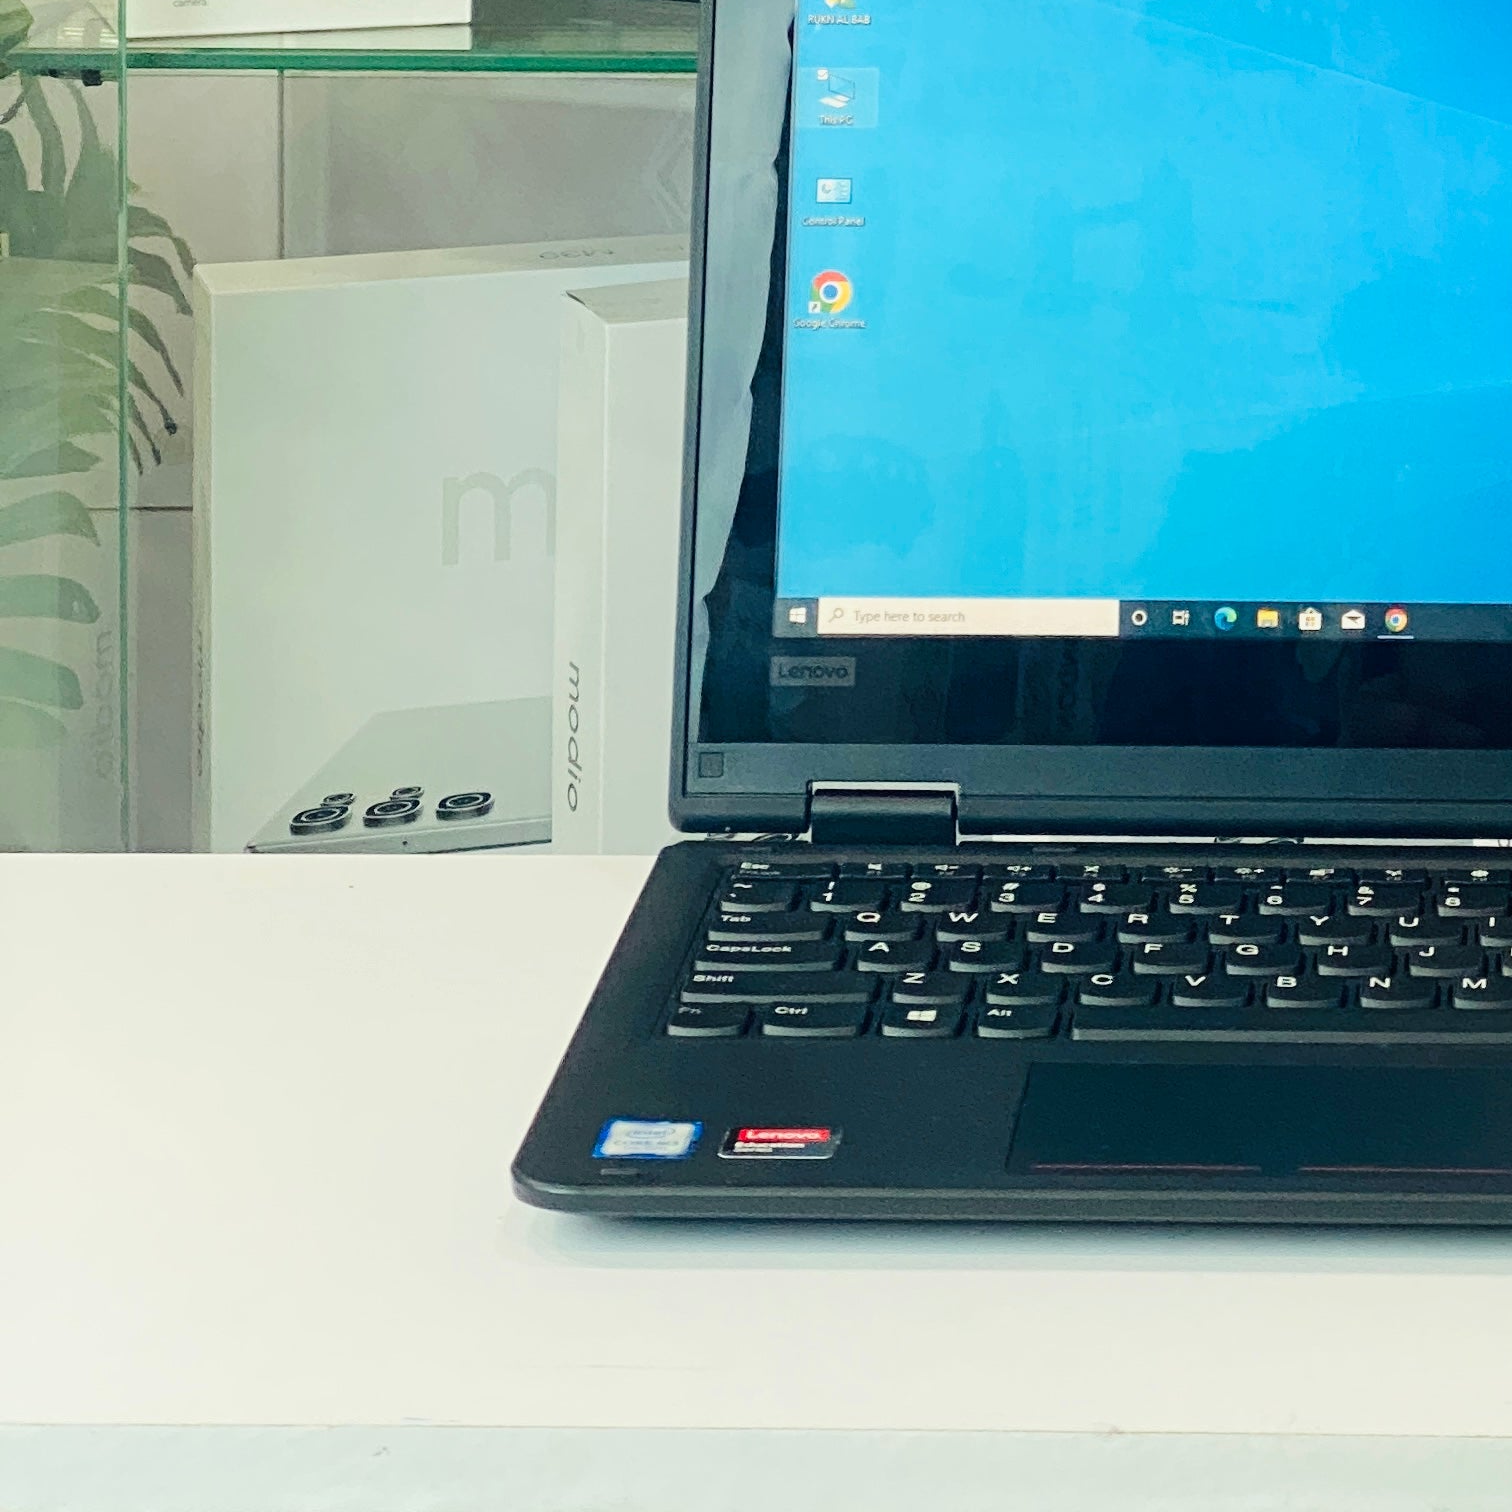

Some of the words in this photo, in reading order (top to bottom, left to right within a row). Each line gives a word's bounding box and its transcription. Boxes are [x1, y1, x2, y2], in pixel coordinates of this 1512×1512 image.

[853, 609, 881, 625] Type
[884, 609, 910, 622] here
[912, 610, 925, 622] to
[927, 609, 965, 623] search
[778, 663, 848, 679] Lenovo
[568, 660, 582, 812] modio
[721, 915, 751, 923] Tab
[856, 912, 881, 923] Q
[949, 912, 978, 923] W
[1037, 913, 1059, 924] E
[1127, 914, 1148, 924] R
[1219, 914, 1240, 925] T
[1309, 915, 1329, 926] Y
[1399, 916, 1419, 928] U
[705, 944, 792, 953] CapsLock
[868, 942, 890, 953] A
[960, 941, 982, 953] S
[1052, 942, 1075, 954] D
[1144, 943, 1163, 954] F
[1236, 944, 1259, 956] G
[1327, 945, 1348, 957] H
[1419, 946, 1435, 957] J
[693, 974, 734, 983] Shift
[902, 972, 925, 984] Z
[997, 973, 1019, 985] X
[1090, 974, 1114, 985] C
[1184, 975, 1207, 987] V
[1276, 976, 1298, 988] B
[1368, 976, 1392, 988] N
[1462, 977, 1487, 989] M
[774, 1006, 808, 1015] Ctrl
